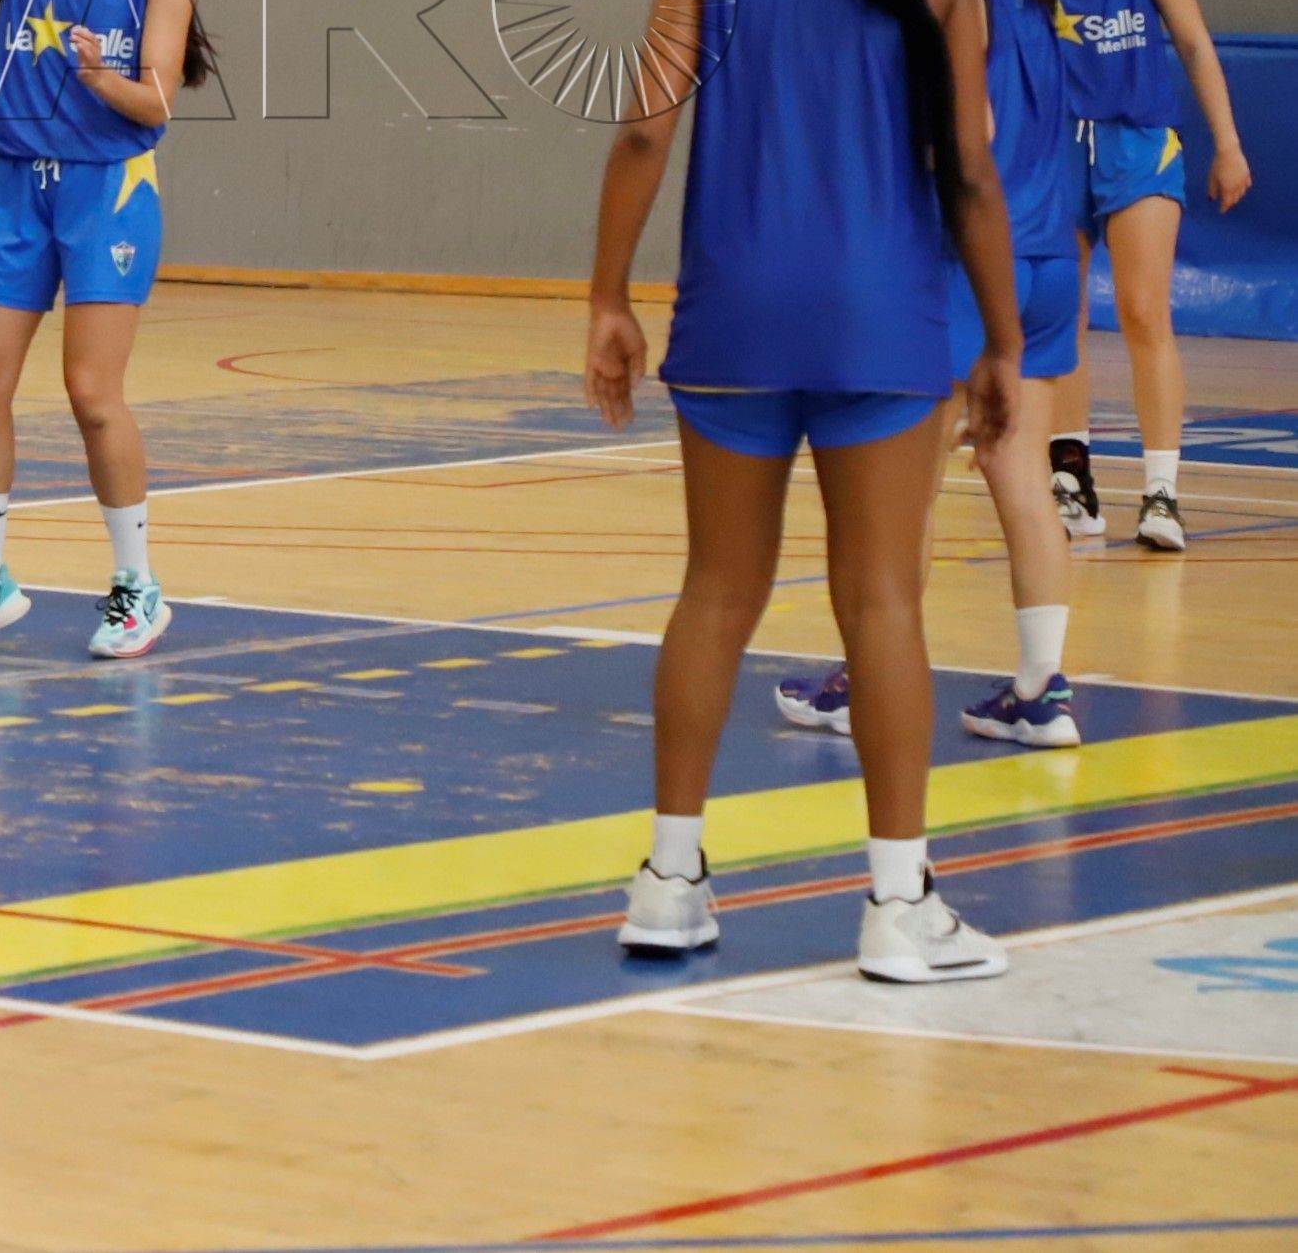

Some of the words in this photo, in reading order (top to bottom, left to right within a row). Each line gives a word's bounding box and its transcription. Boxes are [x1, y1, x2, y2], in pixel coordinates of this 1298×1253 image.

[6, 22, 33, 51] La
[70, 28, 134, 59] alle
[1084, 9, 1145, 41] Salle
